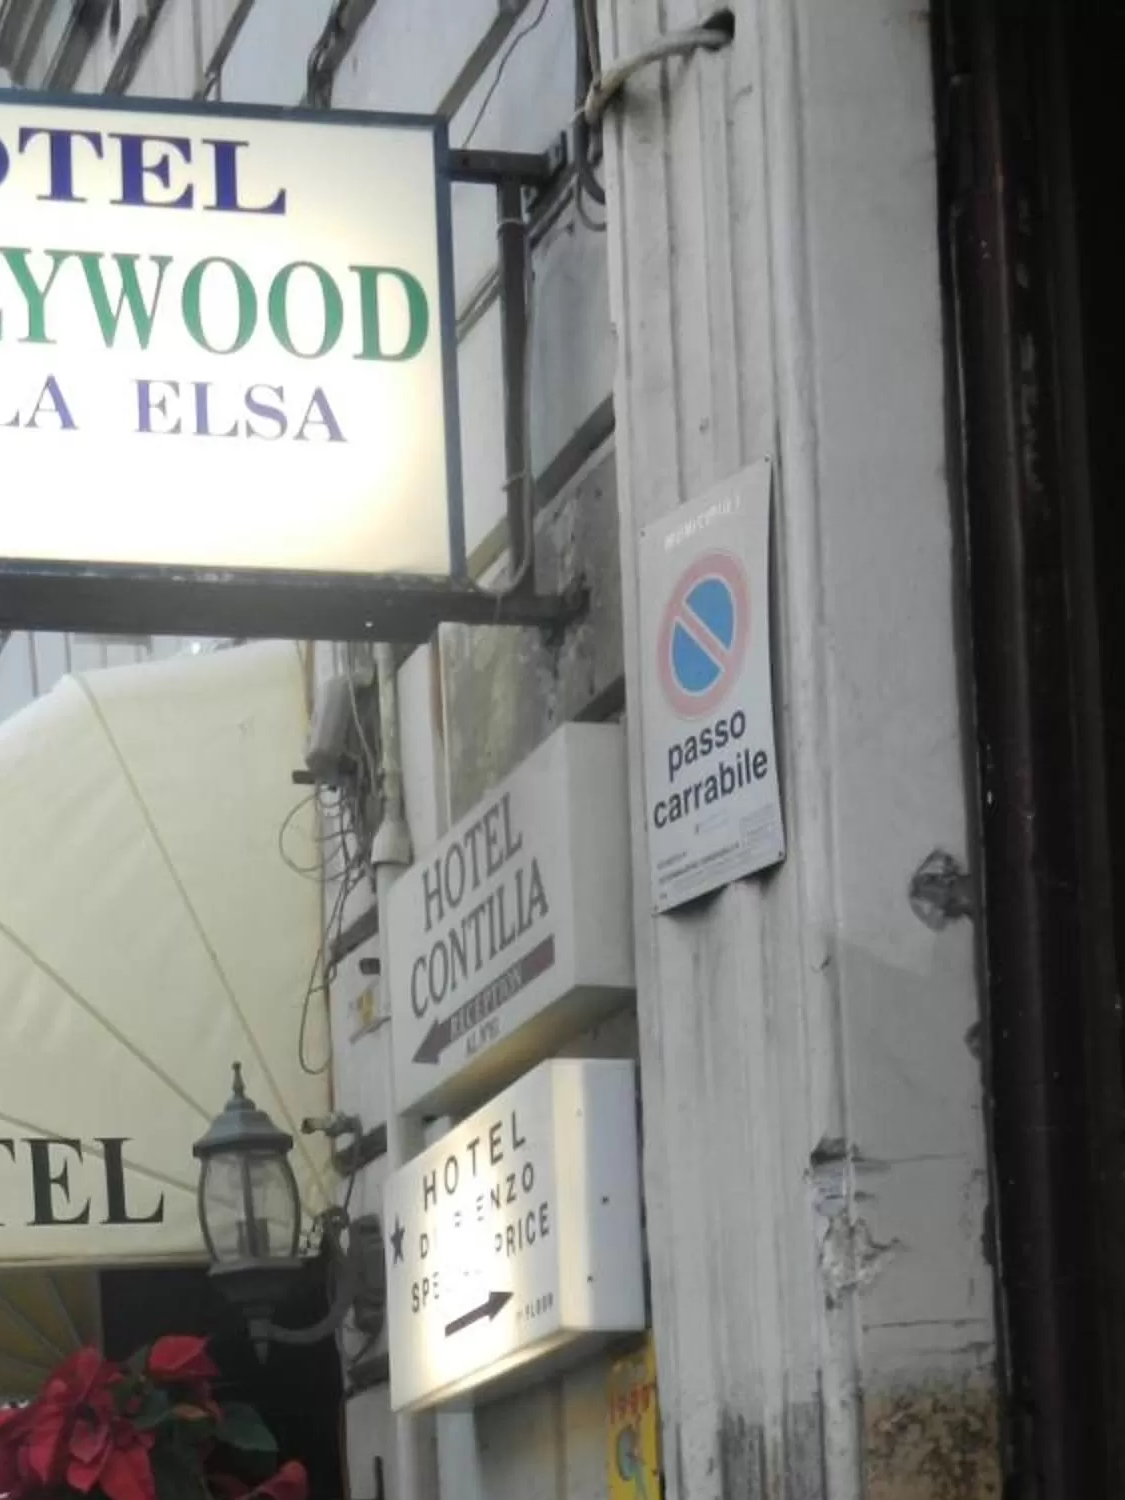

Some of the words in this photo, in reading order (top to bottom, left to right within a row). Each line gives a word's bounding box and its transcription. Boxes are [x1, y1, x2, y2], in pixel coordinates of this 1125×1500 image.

[133, 376, 349, 444] ELSA
[653, 745, 769, 830] carrabile
[667, 708, 747, 782] passo
[422, 792, 524, 933] HOTEL
[411, 856, 549, 1020] CONTILIA
[423, 1110, 527, 1212] HOTEL
